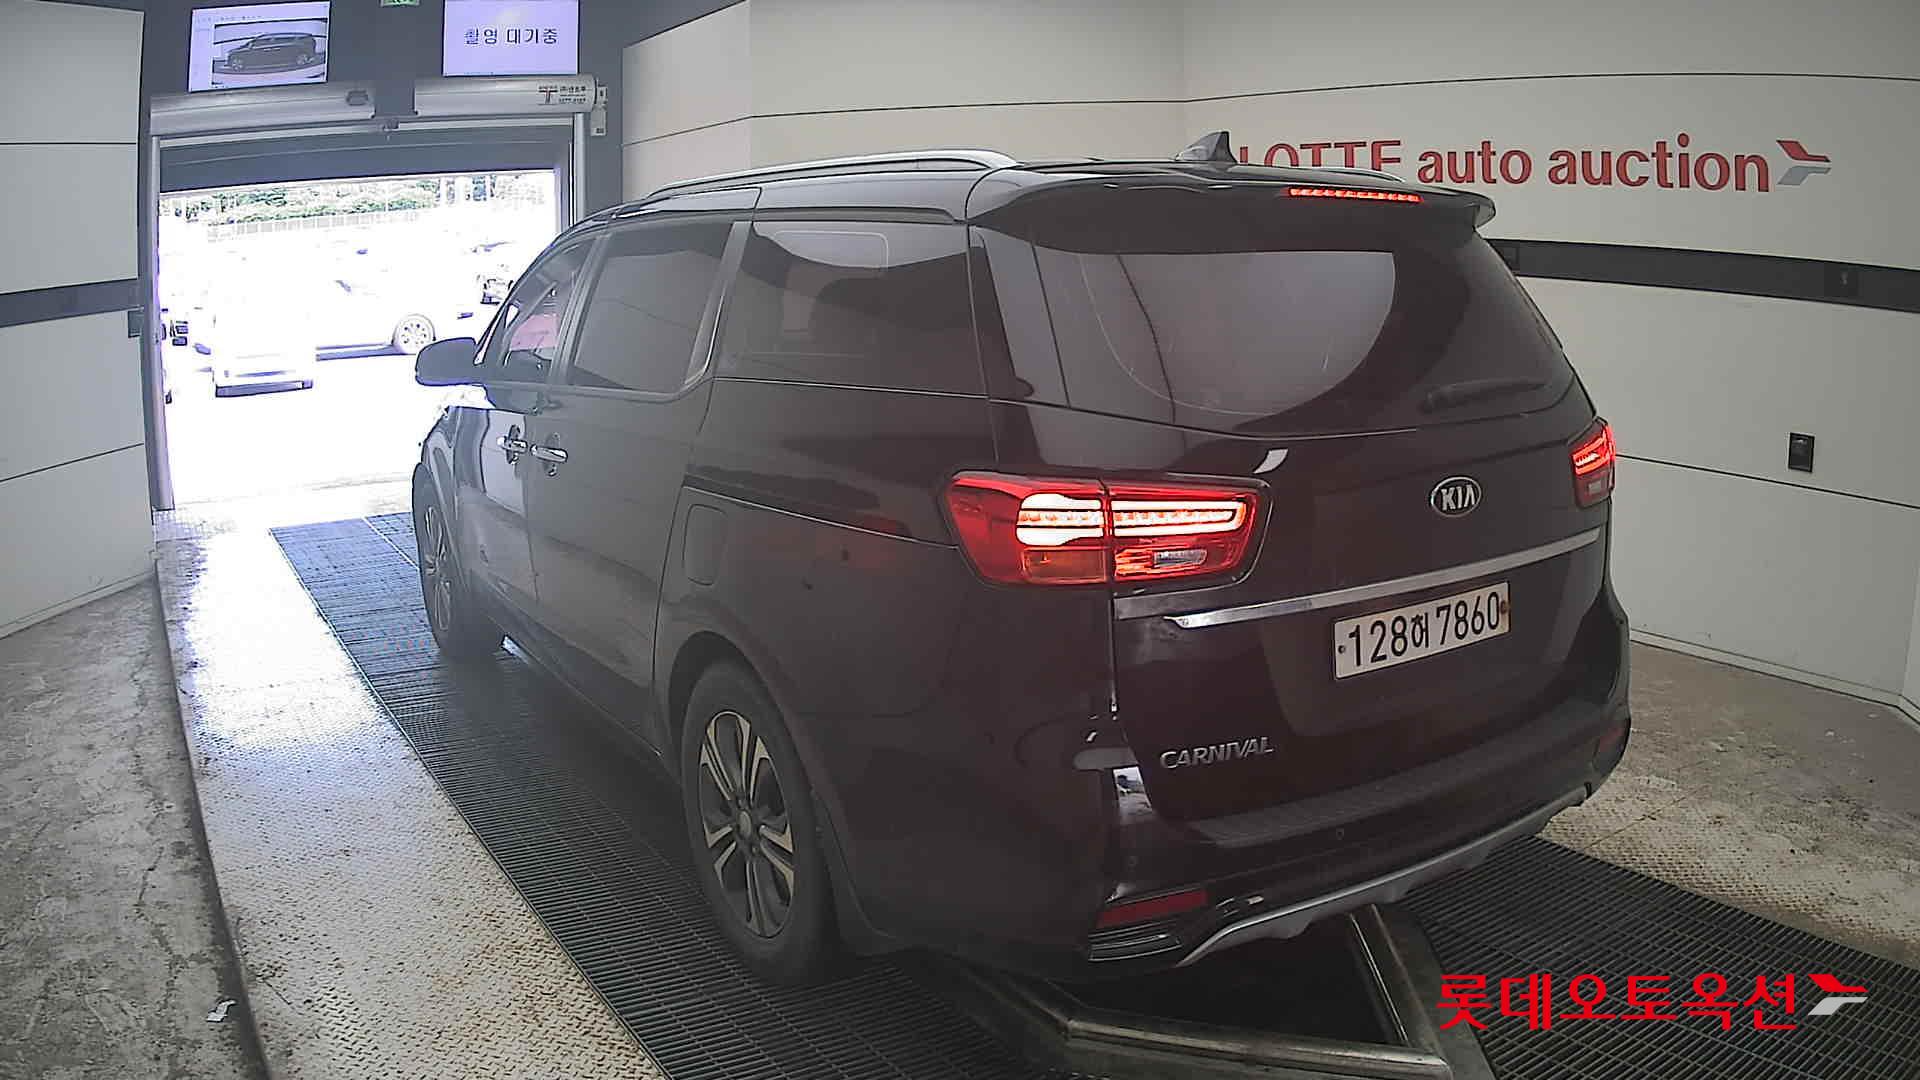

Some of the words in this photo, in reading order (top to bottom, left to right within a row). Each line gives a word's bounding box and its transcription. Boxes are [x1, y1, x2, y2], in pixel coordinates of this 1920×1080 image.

[507, 28, 558, 45] 대기중
[1239, 140, 1401, 172] OTTE
[1417, 140, 1533, 185] auto
[1548, 133, 1770, 192] auction
[1441, 484, 1475, 511] KIA
[1160, 736, 1274, 769] CARNIVAL
